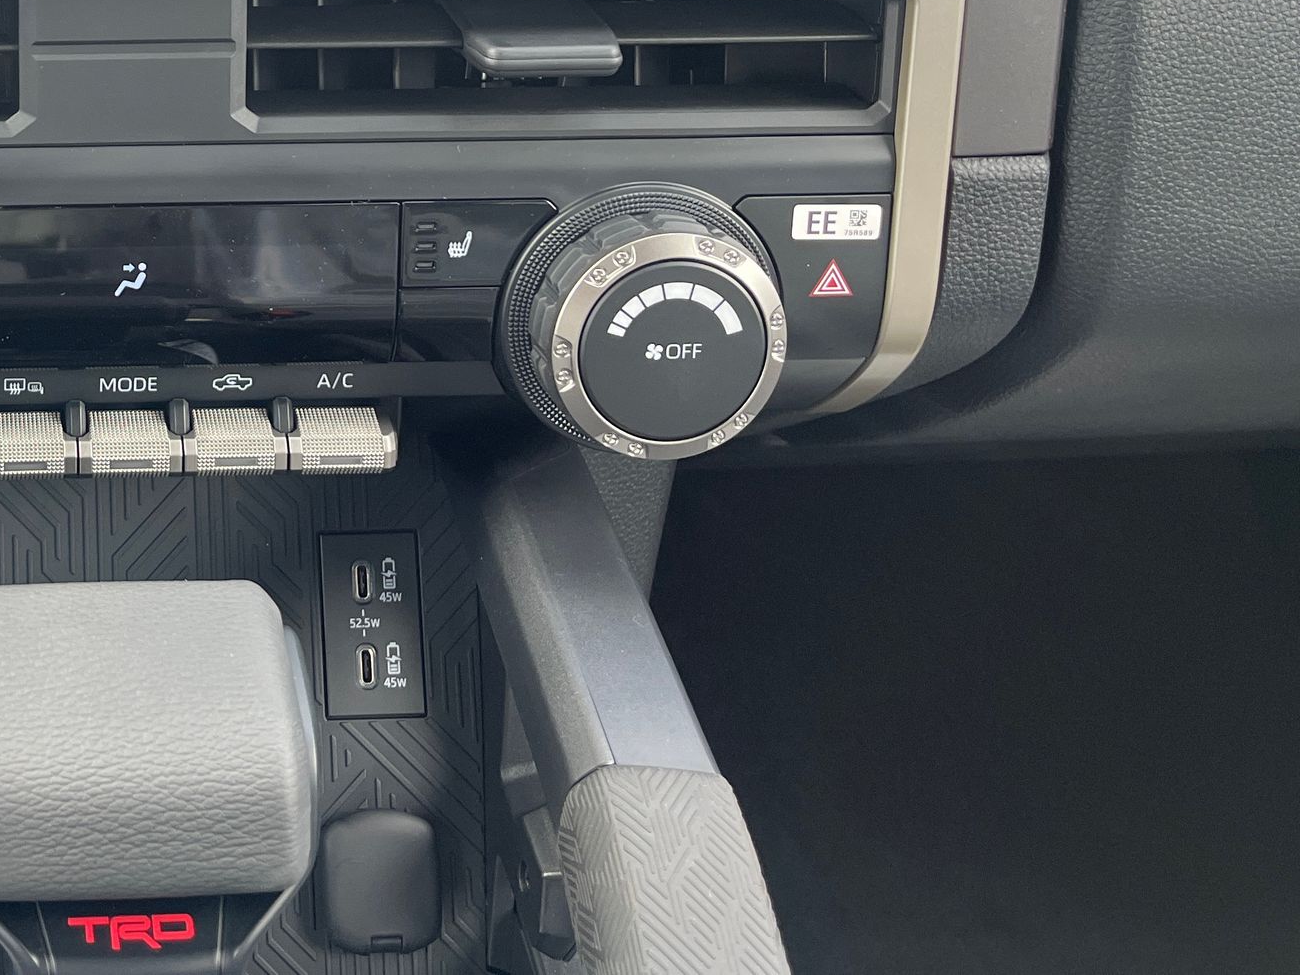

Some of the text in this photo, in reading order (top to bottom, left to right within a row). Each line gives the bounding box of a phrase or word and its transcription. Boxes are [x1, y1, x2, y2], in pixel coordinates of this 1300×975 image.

[806, 211, 838, 235] EE
[665, 343, 703, 360] OFF
[99, 377, 158, 393] MODE
[317, 372, 355, 389] A/C
[379, 591, 402, 602] 45W
[349, 618, 381, 629] 52.5W
[383, 677, 407, 688] 45W
[67, 913, 195, 951] TRD
